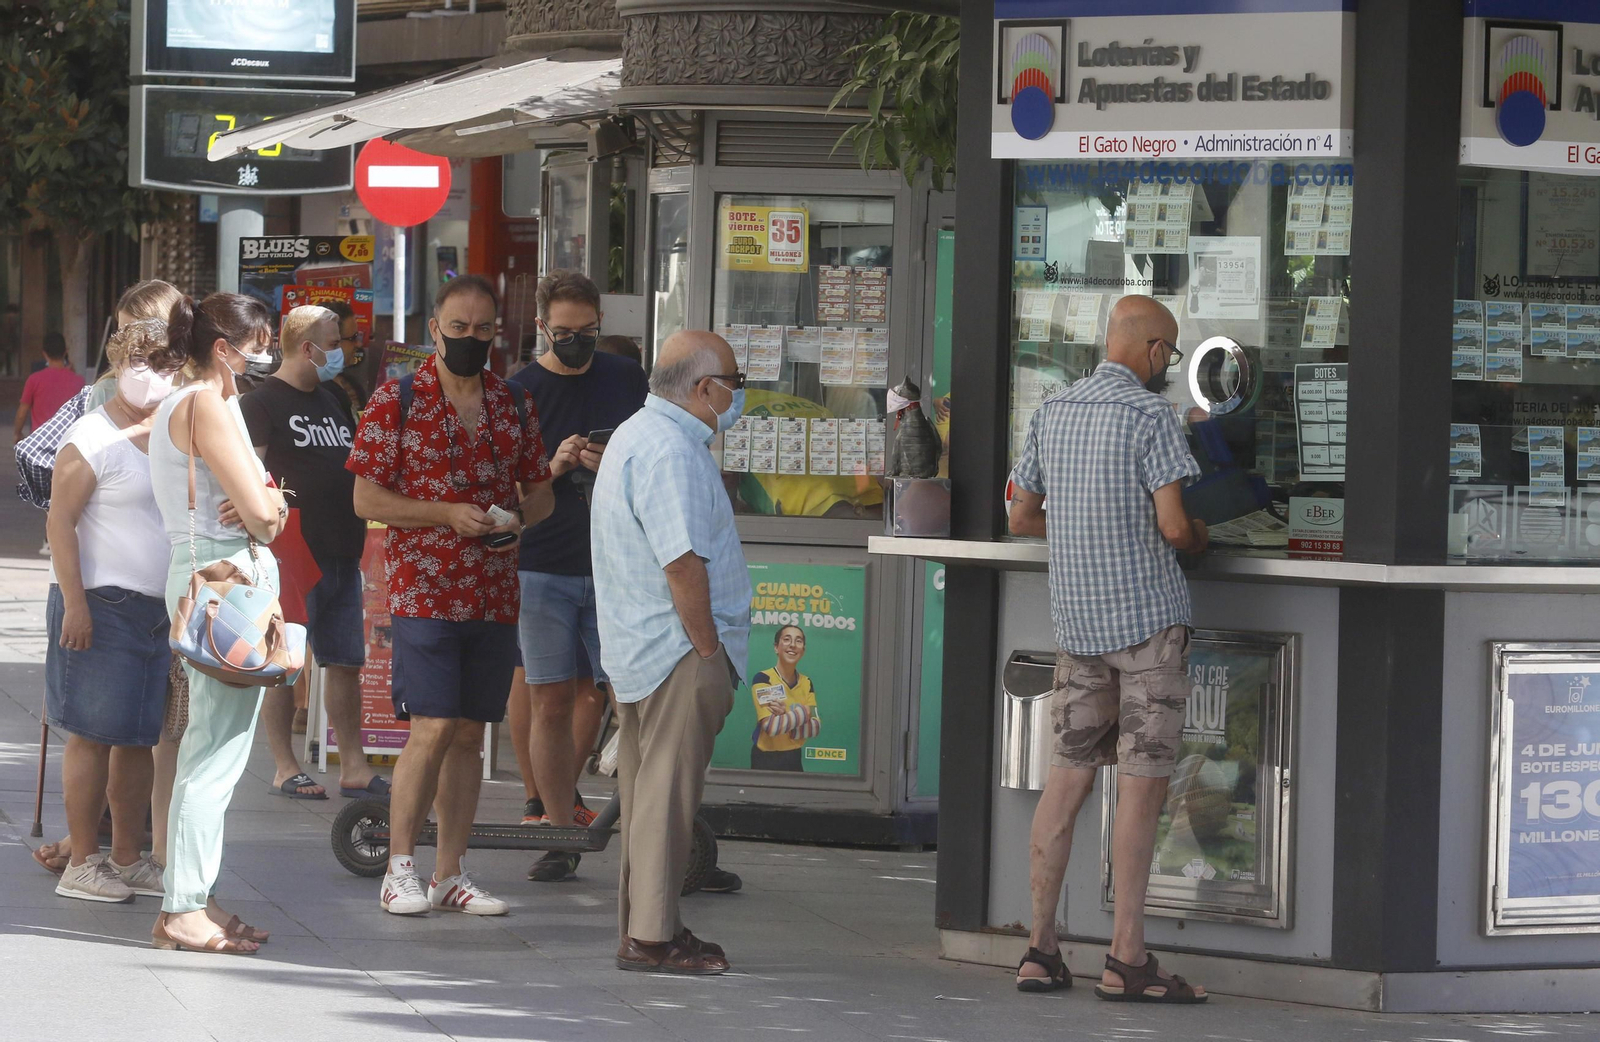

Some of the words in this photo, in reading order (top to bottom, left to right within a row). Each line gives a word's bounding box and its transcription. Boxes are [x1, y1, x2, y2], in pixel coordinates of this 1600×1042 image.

[1077, 38, 1180, 68] Loterías
[1183, 45, 1201, 73] y
[230, 58, 270, 67] JCDecaux
[1077, 77, 1192, 111] Apuestas
[1197, 72, 1238, 103] del
[1242, 72, 1331, 101] Estado
[1078, 136, 1089, 153] El
[1093, 136, 1128, 153] Gato
[1132, 136, 1177, 157] Negro
[1194, 134, 1304, 152] Administración
[1323, 134, 1333, 151] 4
[1567, 145, 1579, 163] El
[728, 211, 757, 222] BOTE
[728, 222, 765, 232] viernes
[771, 219, 801, 244] 35
[242, 238, 310, 259] BLUES
[1551, 238, 1596, 249] 10.528
[770, 250, 802, 258] MILLONES
[1218, 261, 1245, 269] 13954
[310, 289, 347, 298] ANIMALES
[1314, 367, 1337, 379] BOTES
[288, 414, 353, 449] Smile
[1300, 541, 1313, 549] 902
[1322, 542, 1331, 550] 39
[756, 582, 824, 598] CUANDO
[803, 613, 856, 631] TODOS
[1194, 664, 1205, 684] SI
[1208, 665, 1230, 686] CAE
[364, 712, 371, 724] 2
[816, 750, 844, 759] ONCE
[1521, 744, 1536, 757] 4
[1539, 743, 1566, 757] DE
[1520, 761, 1560, 774] BOTE
